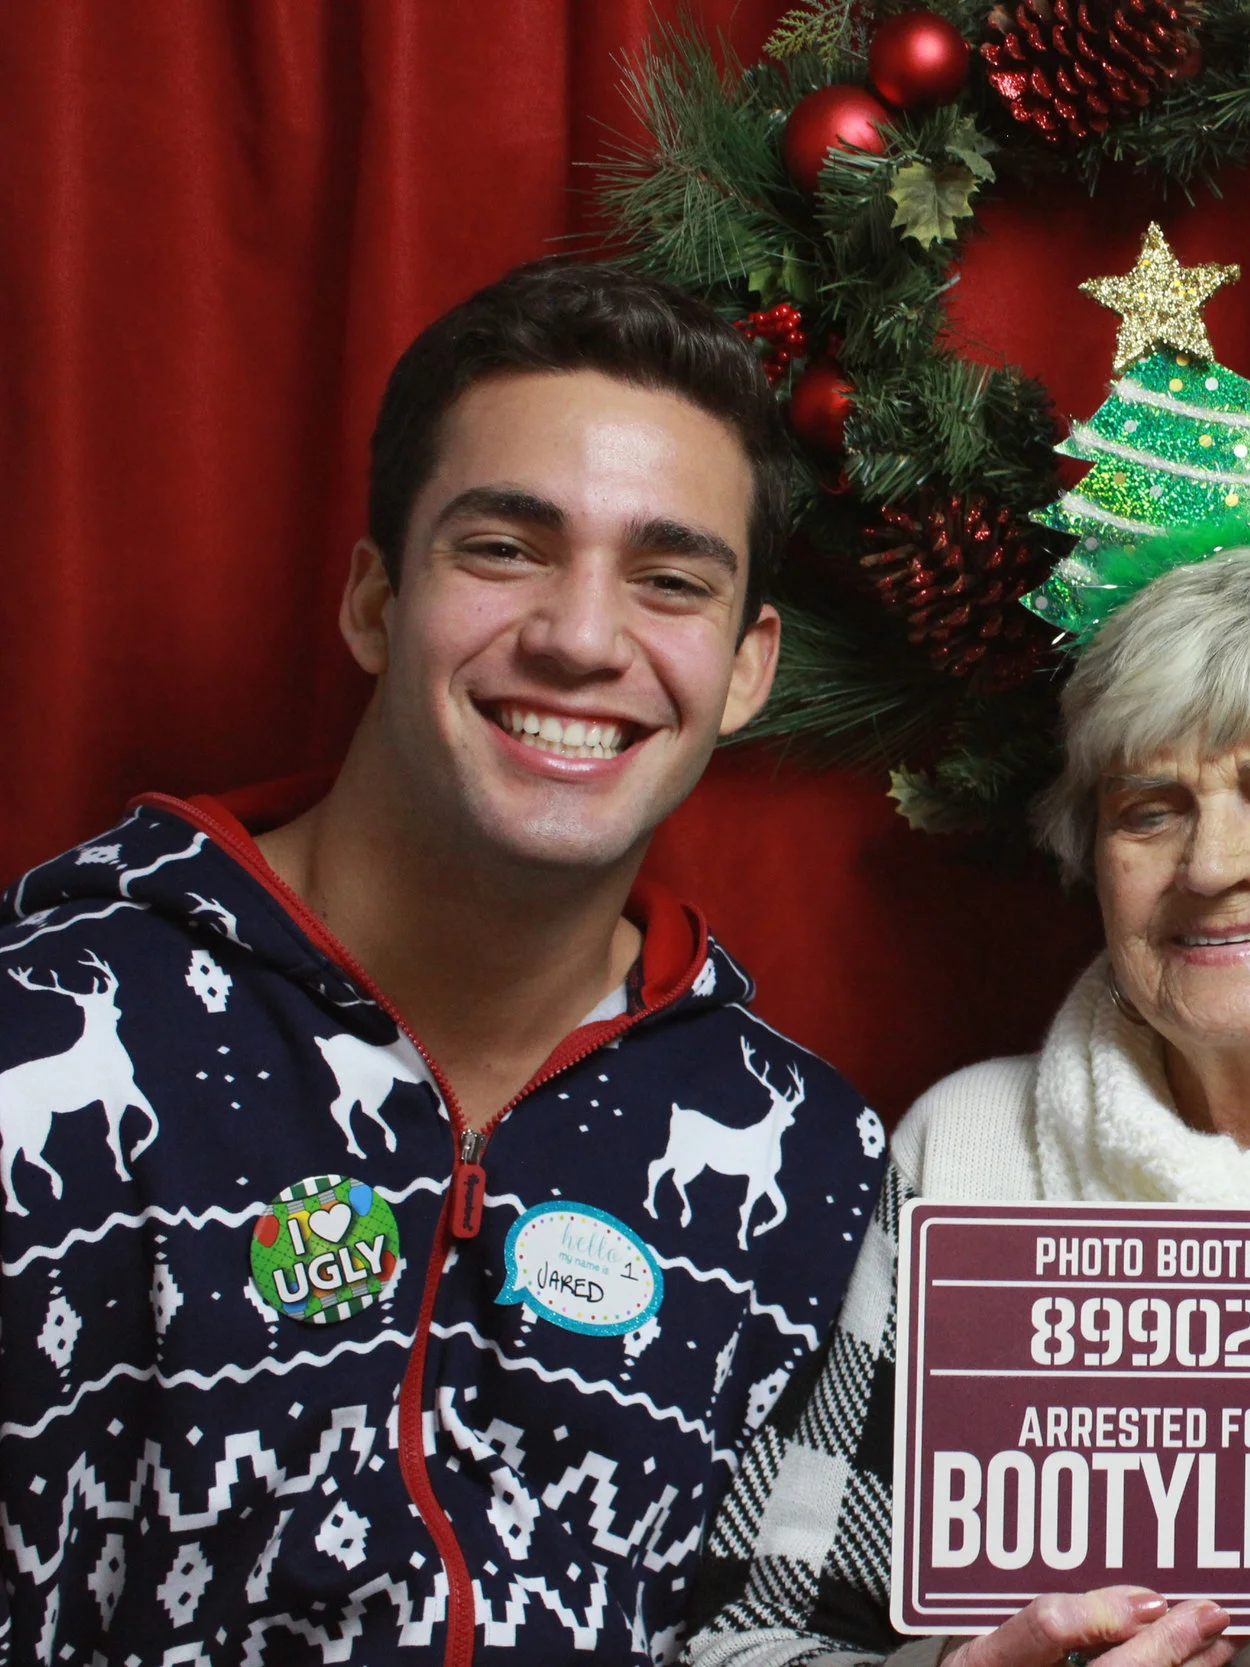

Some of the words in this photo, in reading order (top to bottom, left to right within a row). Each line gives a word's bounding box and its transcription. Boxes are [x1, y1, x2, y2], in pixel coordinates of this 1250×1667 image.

[287, 1217, 306, 1256] I
[561, 1222, 622, 1264] hello
[1036, 1237, 1144, 1277] PHOTO
[272, 1234, 386, 1304] UGLY
[537, 1260, 604, 1303] JARED
[559, 1251, 573, 1265] my
[574, 1258, 600, 1272] name
[602, 1266, 610, 1276] is
[620, 1261, 639, 1282] 1
[1018, 1406, 1207, 1449] ARRESTED
